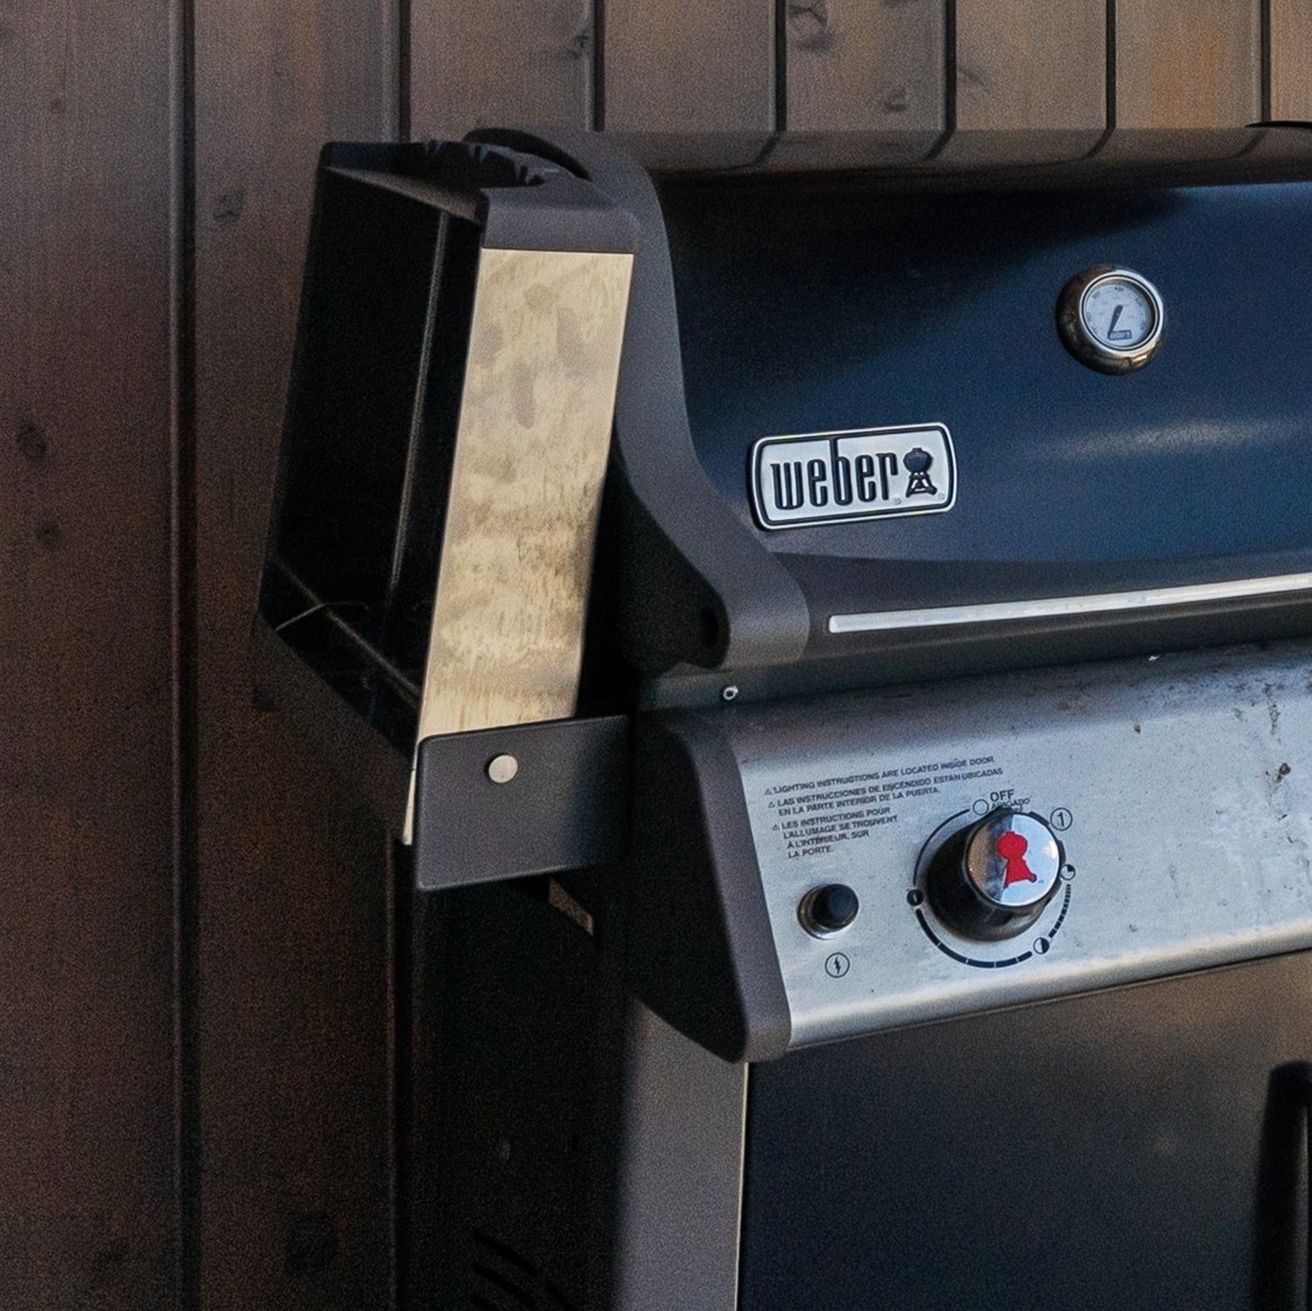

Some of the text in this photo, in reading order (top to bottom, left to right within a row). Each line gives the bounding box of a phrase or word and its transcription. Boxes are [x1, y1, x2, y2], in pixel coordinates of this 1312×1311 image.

[770, 439, 898, 510] weber
[773, 781, 815, 794] LIGHTING
[816, 772, 880, 787] INSTRUCTIONS
[881, 769, 899, 778] ARE
[900, 763, 939, 776] LOCATED
[941, 760, 967, 769] INSIDE
[777, 797, 795, 807] LAS
[796, 788, 866, 804] INSTRUCCIONES
[868, 785, 880, 793] DE
[882, 778, 931, 791] ENCENDIDO
[961, 768, 1003, 780] UBICADAS
[779, 808, 791, 816] EN
[792, 807, 804, 815] LA
[806, 802, 834, 812] PARTE
[836, 795, 877, 807] INTERIOR
[879, 793, 890, 801] DE
[892, 792, 904, 800] LA
[990, 789, 1014, 802] OFF
[781, 807, 890, 830] LES INSTRUCTIONS POUR
[839, 822, 850, 830] SE
[851, 814, 898, 828] TROUVENT
[851, 830, 869, 839] SUR
[788, 850, 800, 859] LA
